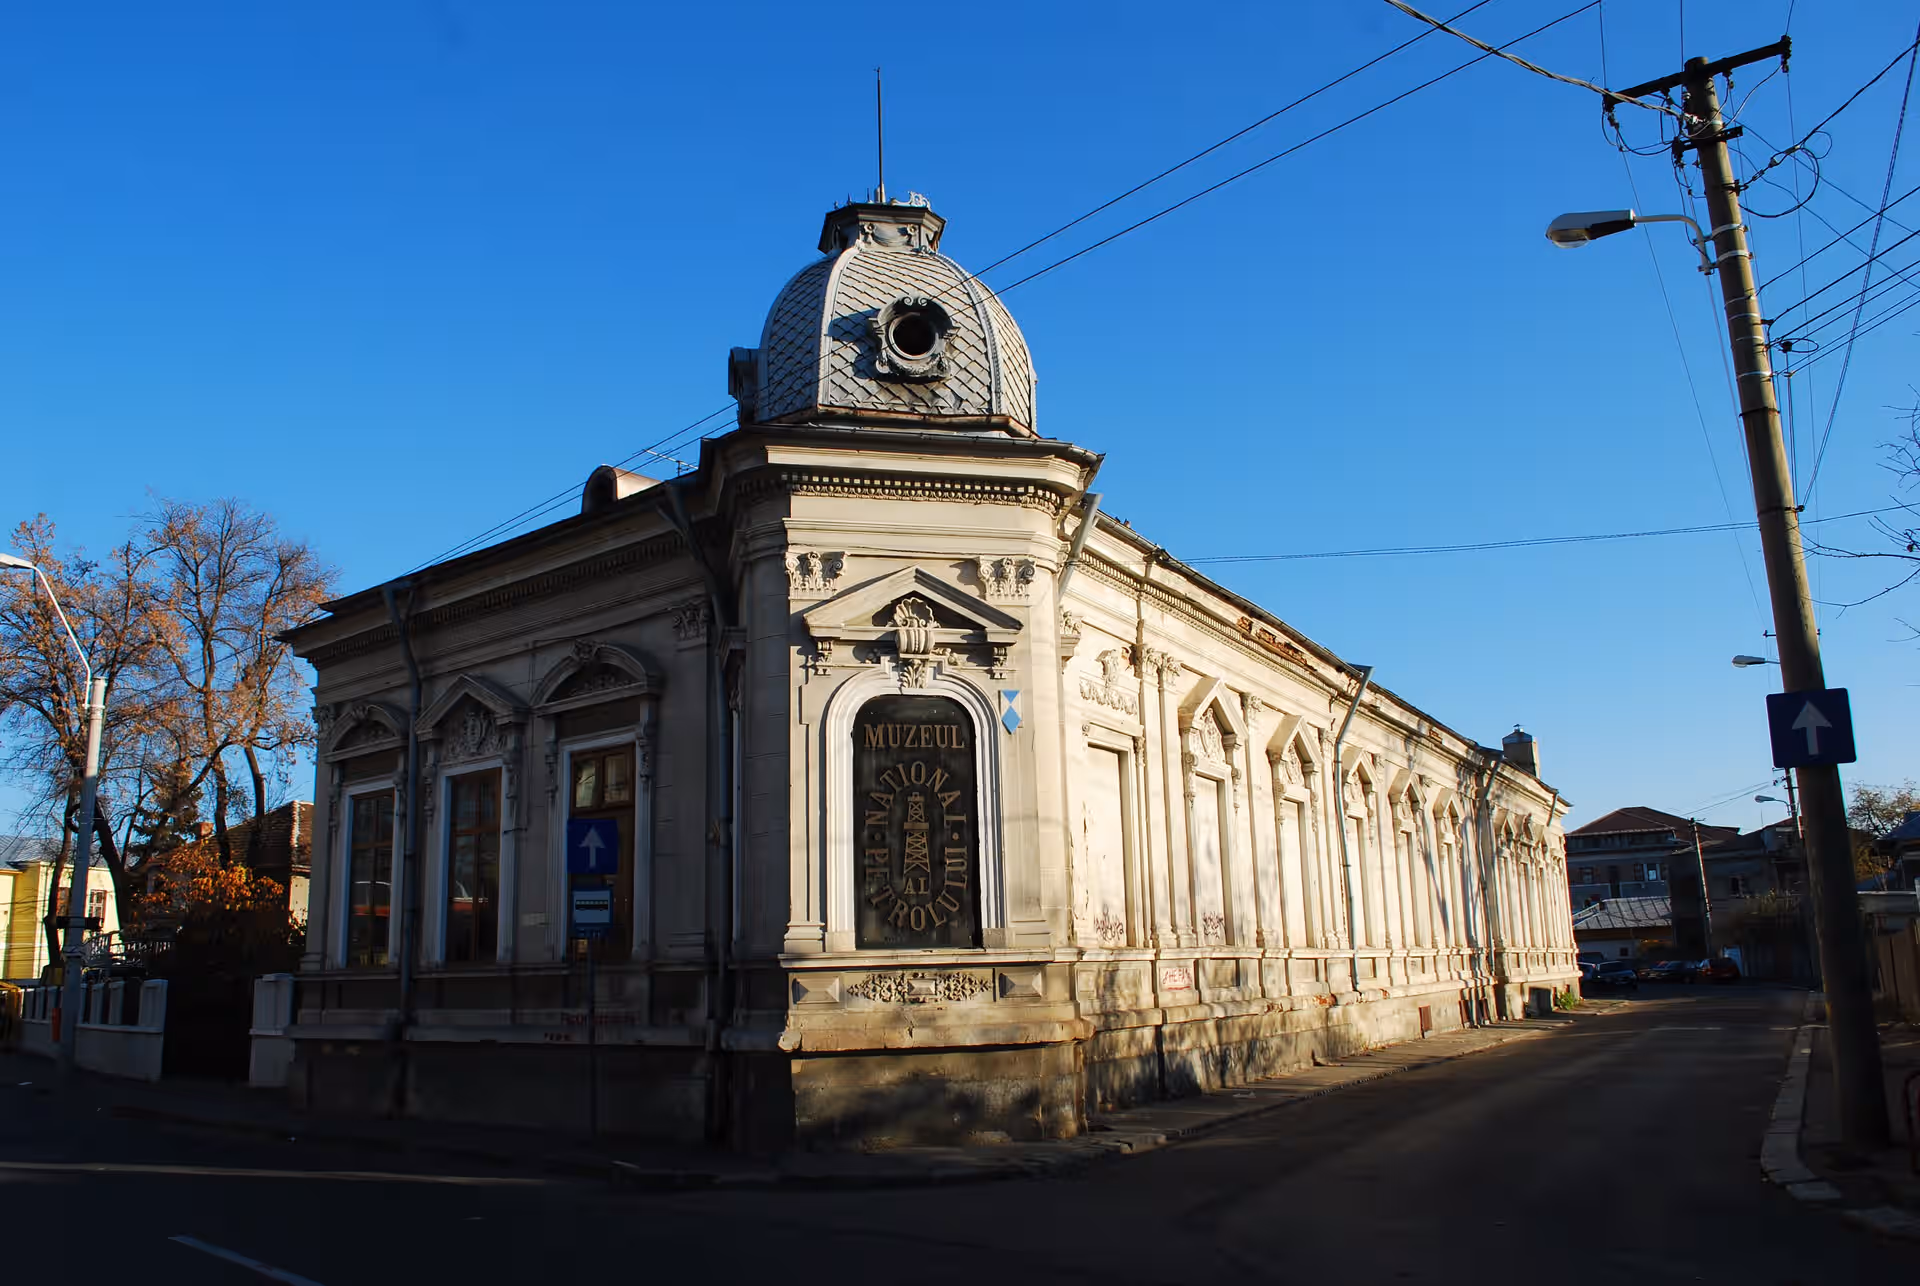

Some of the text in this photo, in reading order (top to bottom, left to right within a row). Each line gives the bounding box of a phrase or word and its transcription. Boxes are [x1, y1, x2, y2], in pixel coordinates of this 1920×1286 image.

[863, 723, 965, 749] MUZEUL
[865, 760, 967, 829] NATIONAL
[865, 846, 968, 932] PETROLULUI
[903, 877, 929, 895] AL
